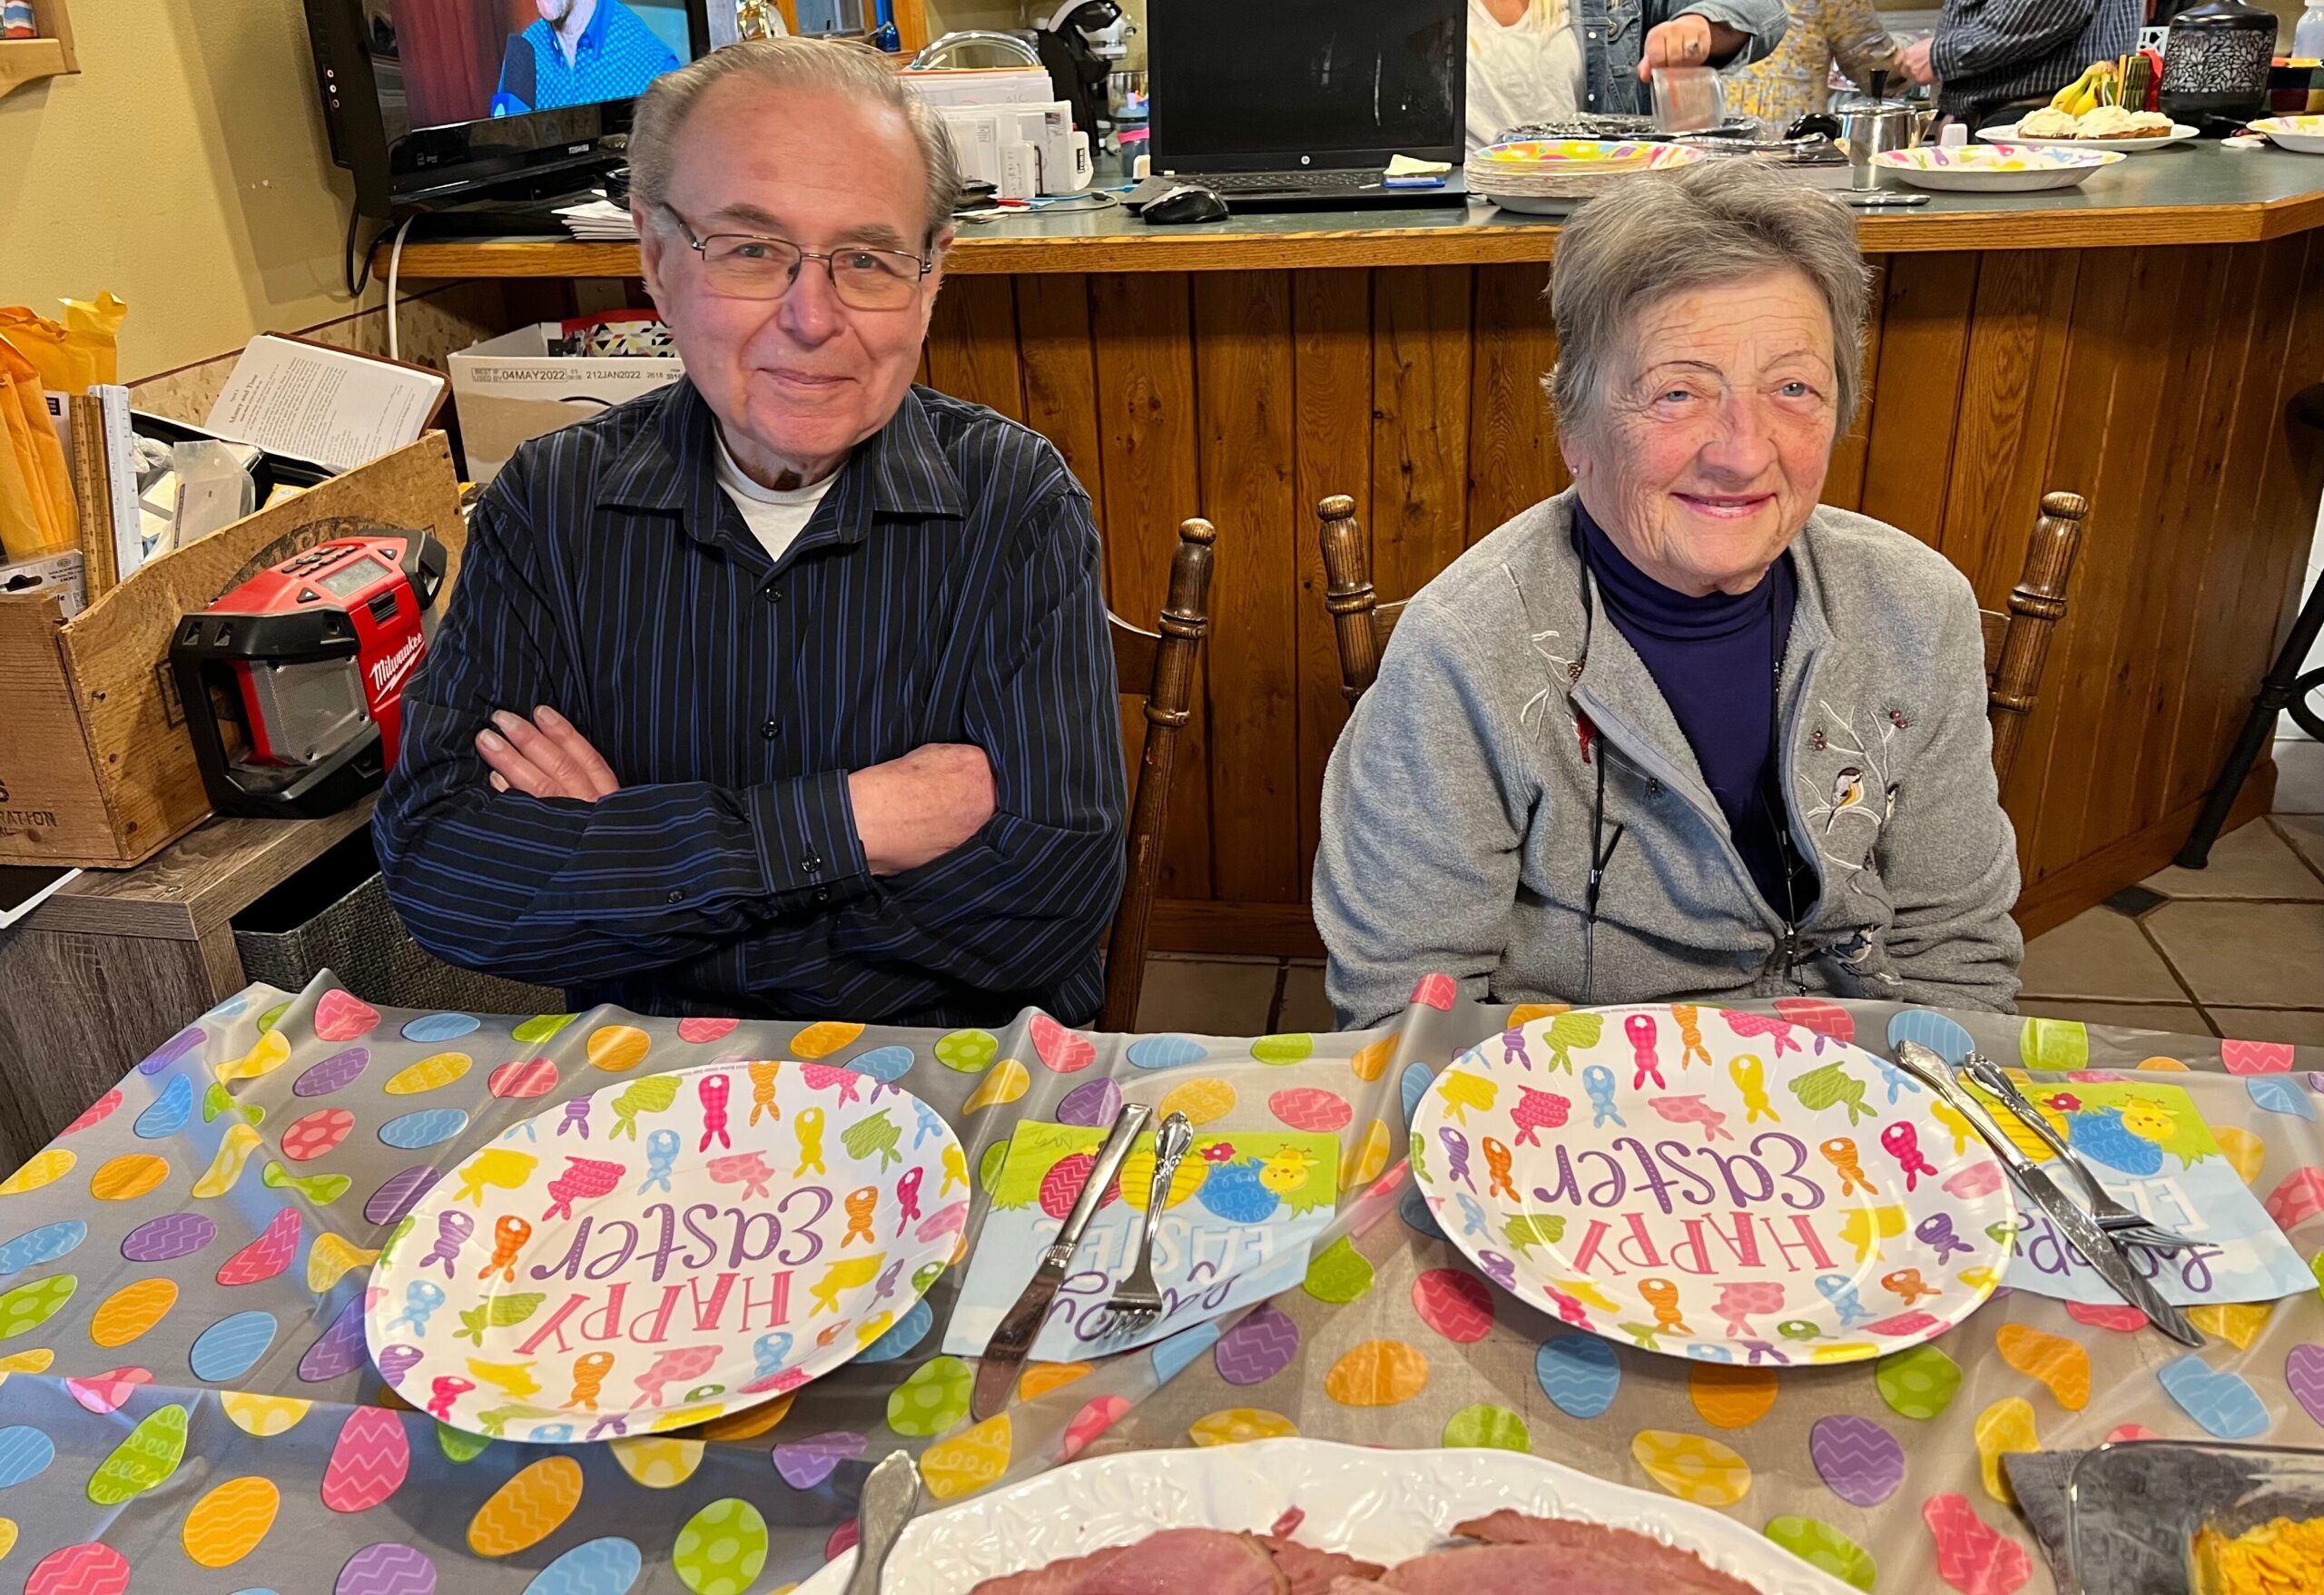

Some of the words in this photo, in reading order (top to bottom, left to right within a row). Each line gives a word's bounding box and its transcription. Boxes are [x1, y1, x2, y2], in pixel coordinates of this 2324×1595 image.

[228, 403, 244, 423] Money
[241, 389, 250, 402] and
[246, 374, 258, 389] Time
[502, 370, 566, 380] 04MAY2022
[369, 632, 424, 691] Milwaukee
[1532, 1131, 1826, 1216] Easter
[530, 1186, 833, 1282] Easter
[1564, 1211, 1839, 1276] HAPPY
[513, 1270, 795, 1355] HAPPY
